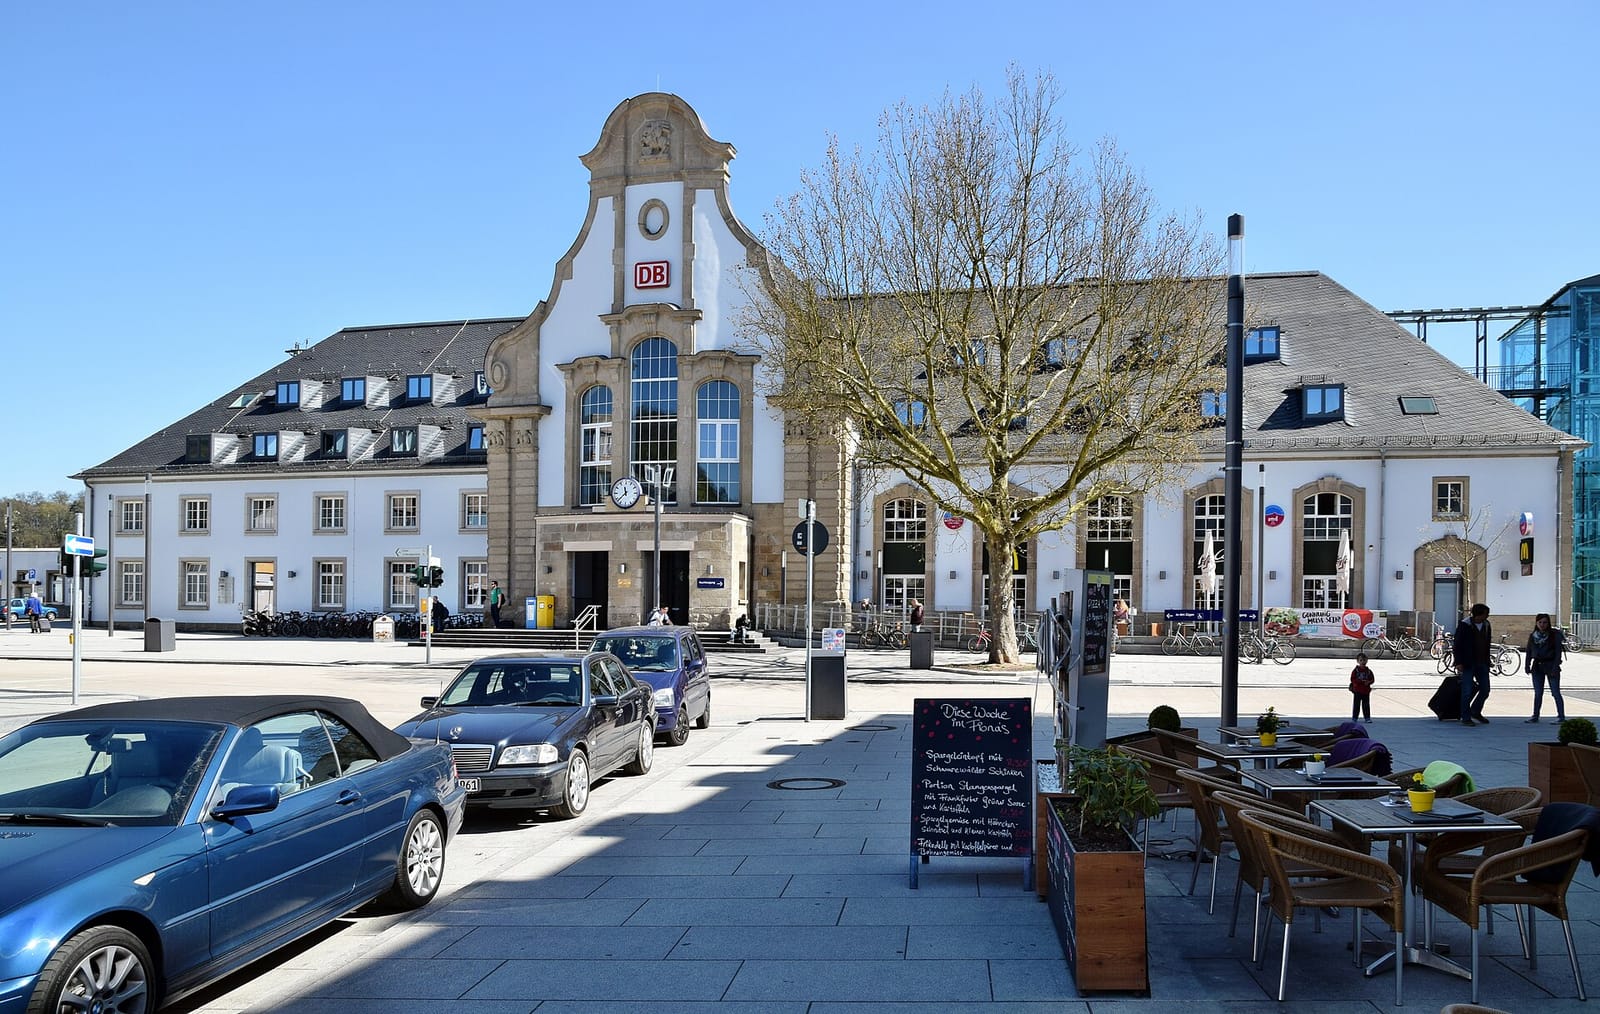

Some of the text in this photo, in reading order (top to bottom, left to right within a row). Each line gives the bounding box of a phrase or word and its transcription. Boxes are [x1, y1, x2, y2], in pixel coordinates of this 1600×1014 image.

[639, 265, 665, 284] DB
[940, 703, 1011, 720] Diese Woche
[951, 718, 966, 728] im
[925, 749, 1003, 764] Spargeleintopf mit
[988, 766, 1025, 778] Schinken
[921, 778, 955, 791] Portion
[924, 792, 937, 801] mit
[972, 817, 986, 826] mit
